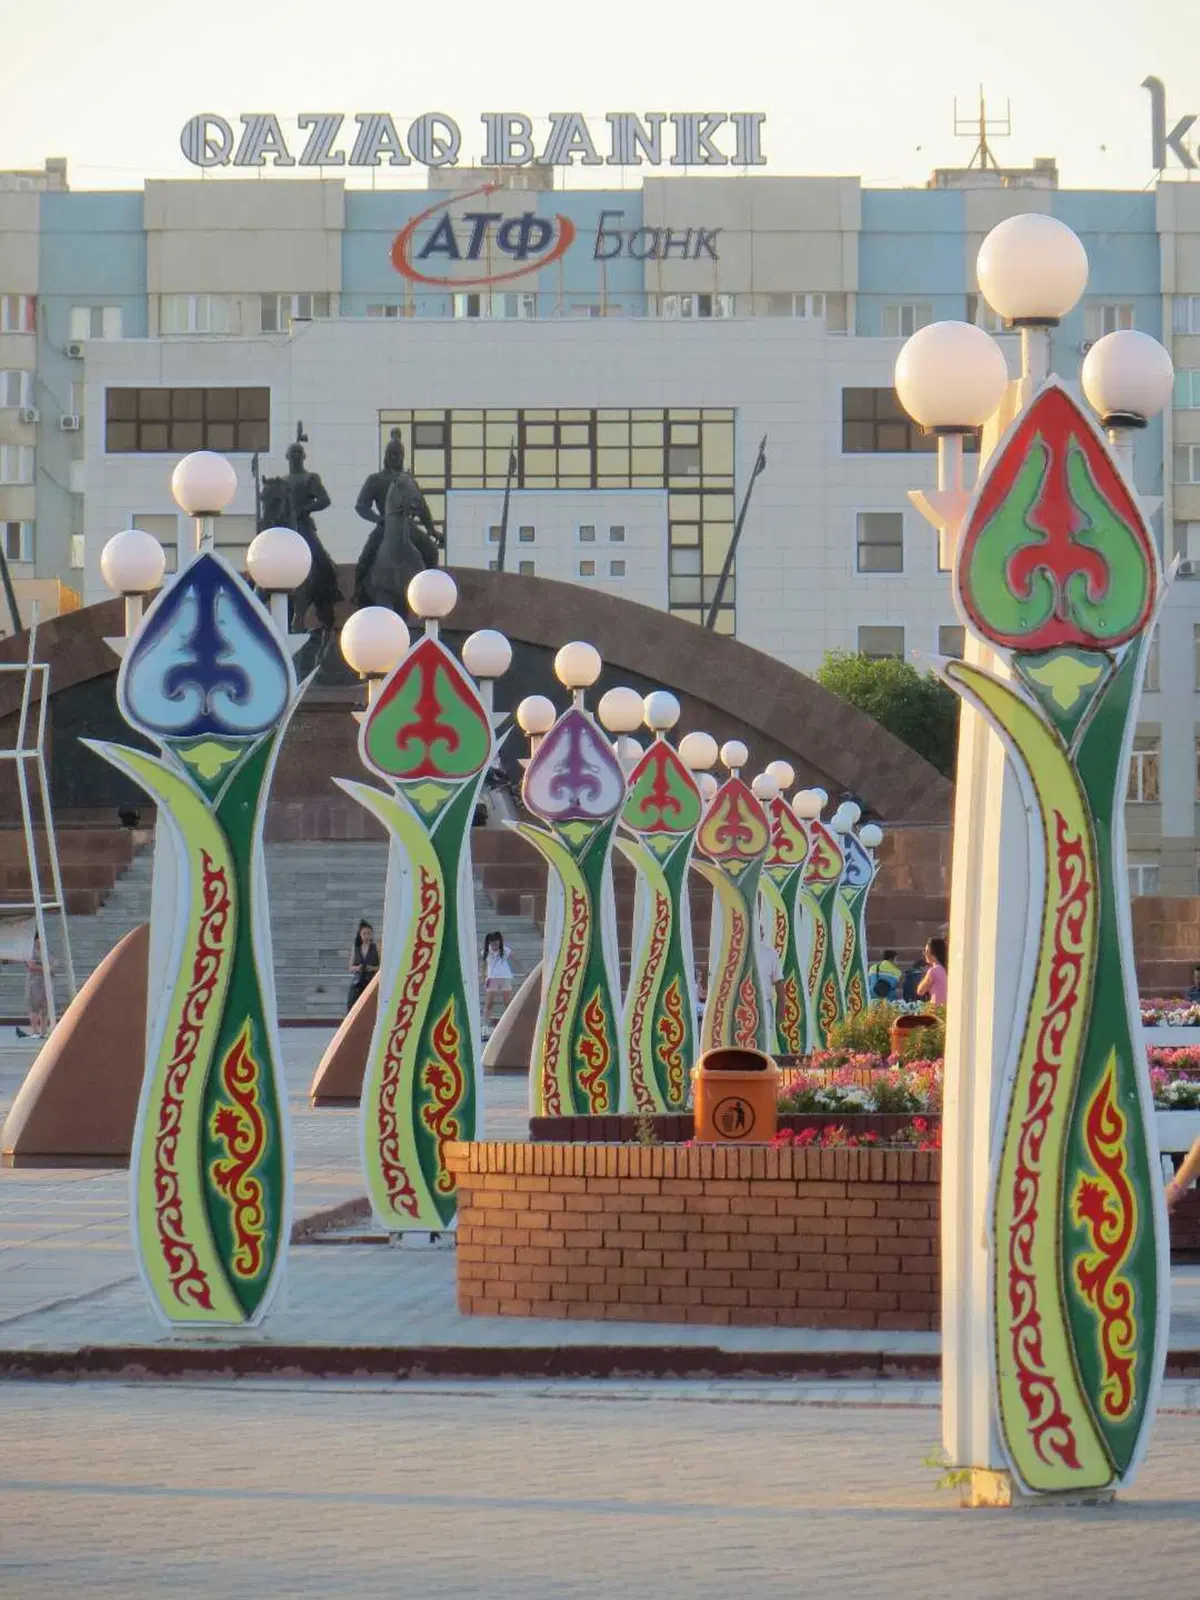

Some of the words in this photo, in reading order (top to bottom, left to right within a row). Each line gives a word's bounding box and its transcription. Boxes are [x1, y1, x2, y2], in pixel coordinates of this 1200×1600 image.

[180, 112, 462, 167] QAZAQ
[481, 112, 766, 165] BANKI
[1140, 75, 1200, 170] k
[416, 211, 554, 260] АТФ
[593, 209, 722, 260] Банк
